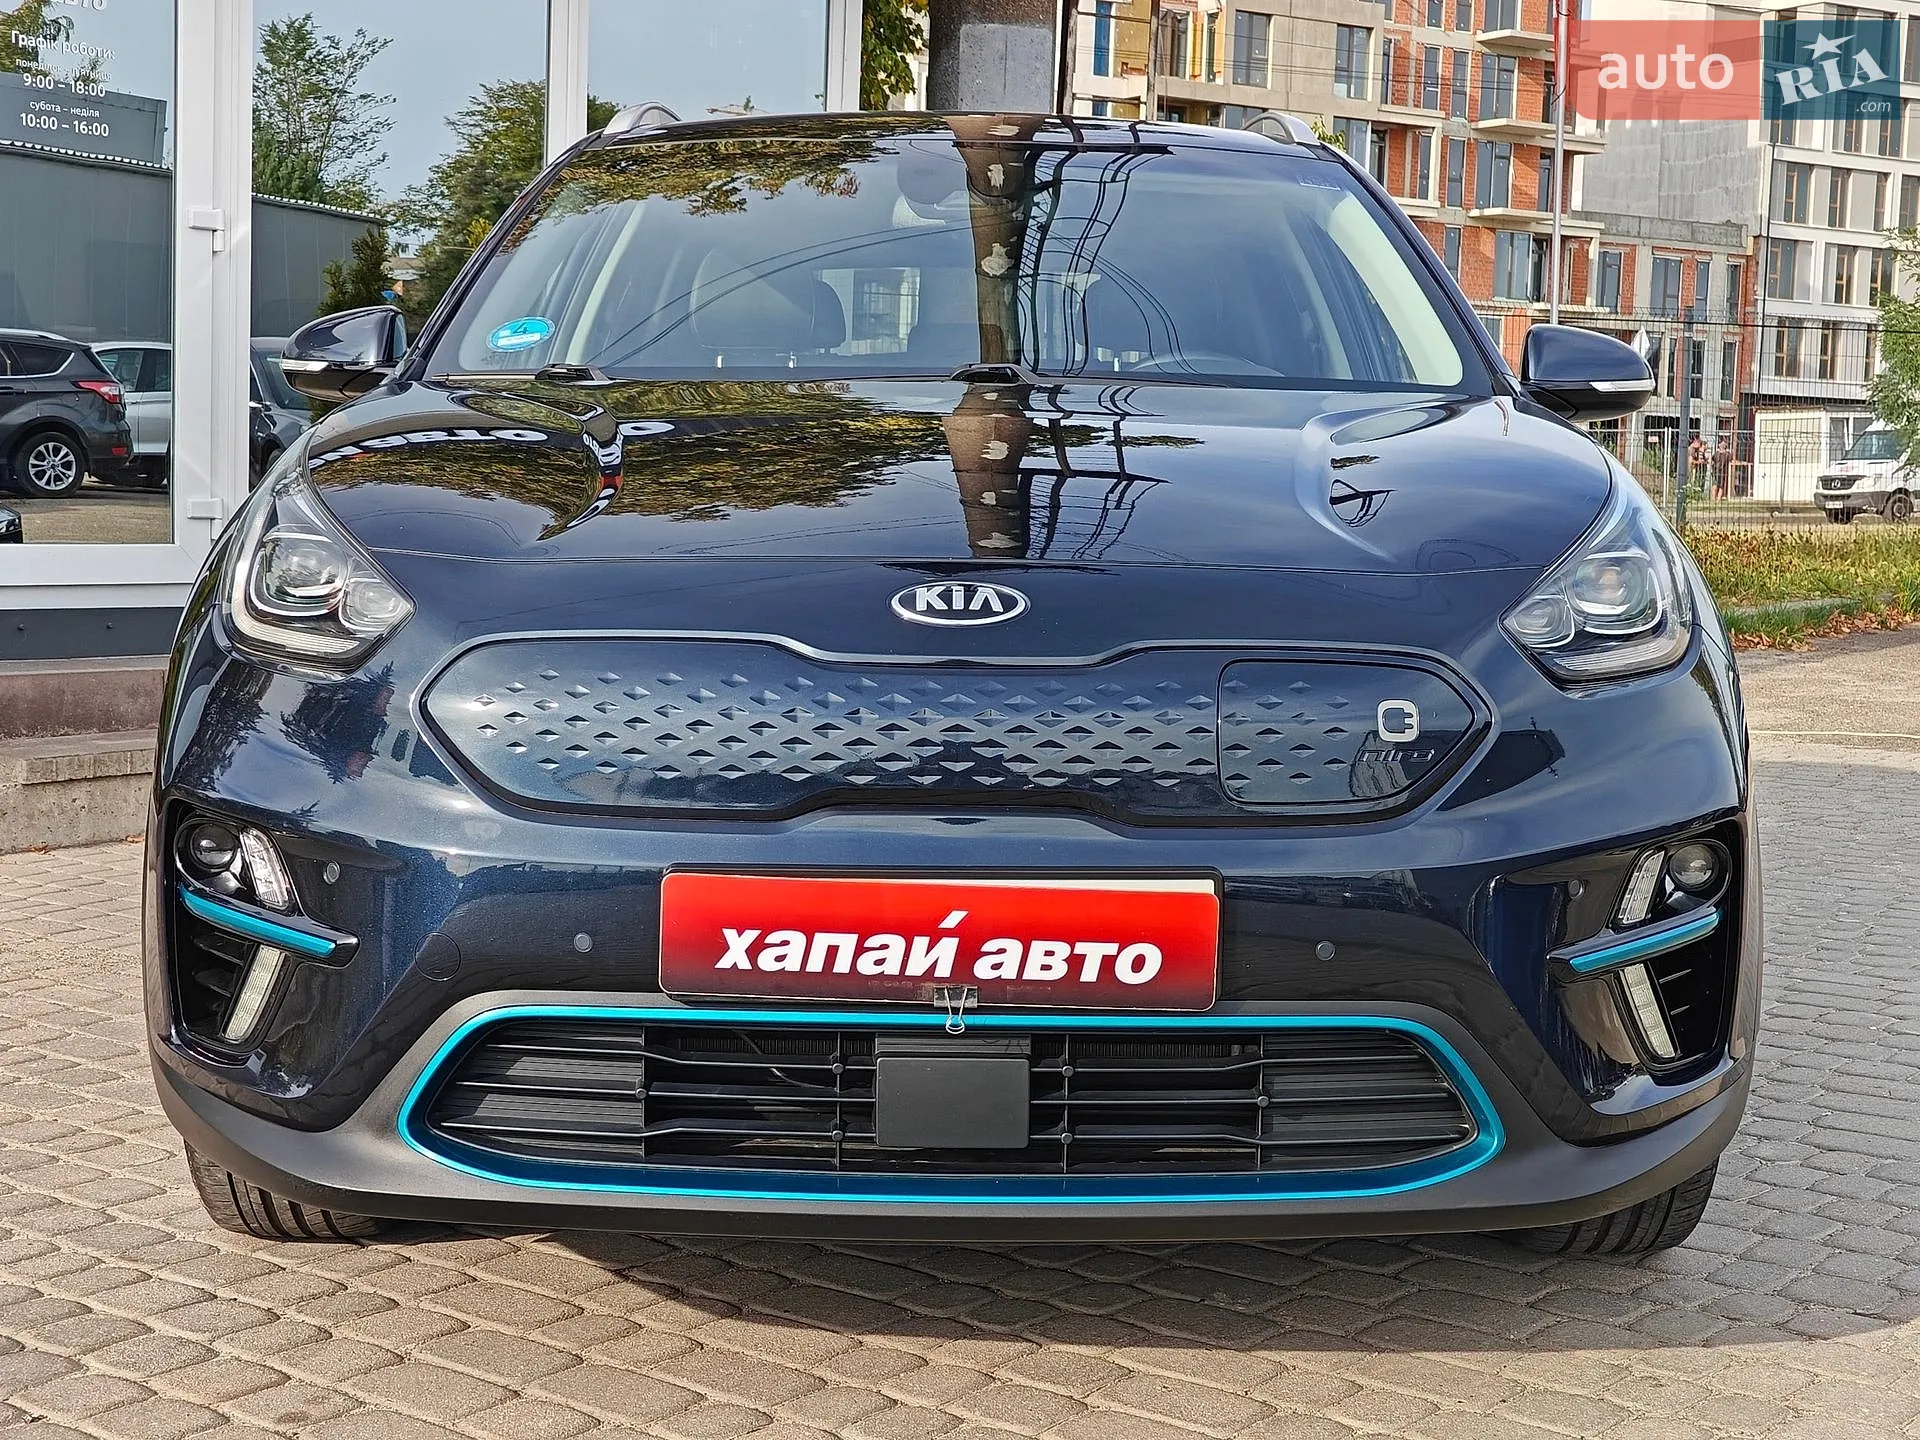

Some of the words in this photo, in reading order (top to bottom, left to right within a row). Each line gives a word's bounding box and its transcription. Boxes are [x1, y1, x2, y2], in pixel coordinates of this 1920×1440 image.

[11, 30, 59, 51] Графік
[23, 73, 54, 90] 9:00
[70, 80, 106, 97] 18:00
[30, 101, 61, 113] субота
[71, 107, 100, 118] неділя
[20, 112, 58, 130] 10:00
[73, 120, 109, 137] 16:00
[512, 322, 529, 335] 4
[914, 585, 1004, 613] KIA
[972, 935, 1163, 985] авто
